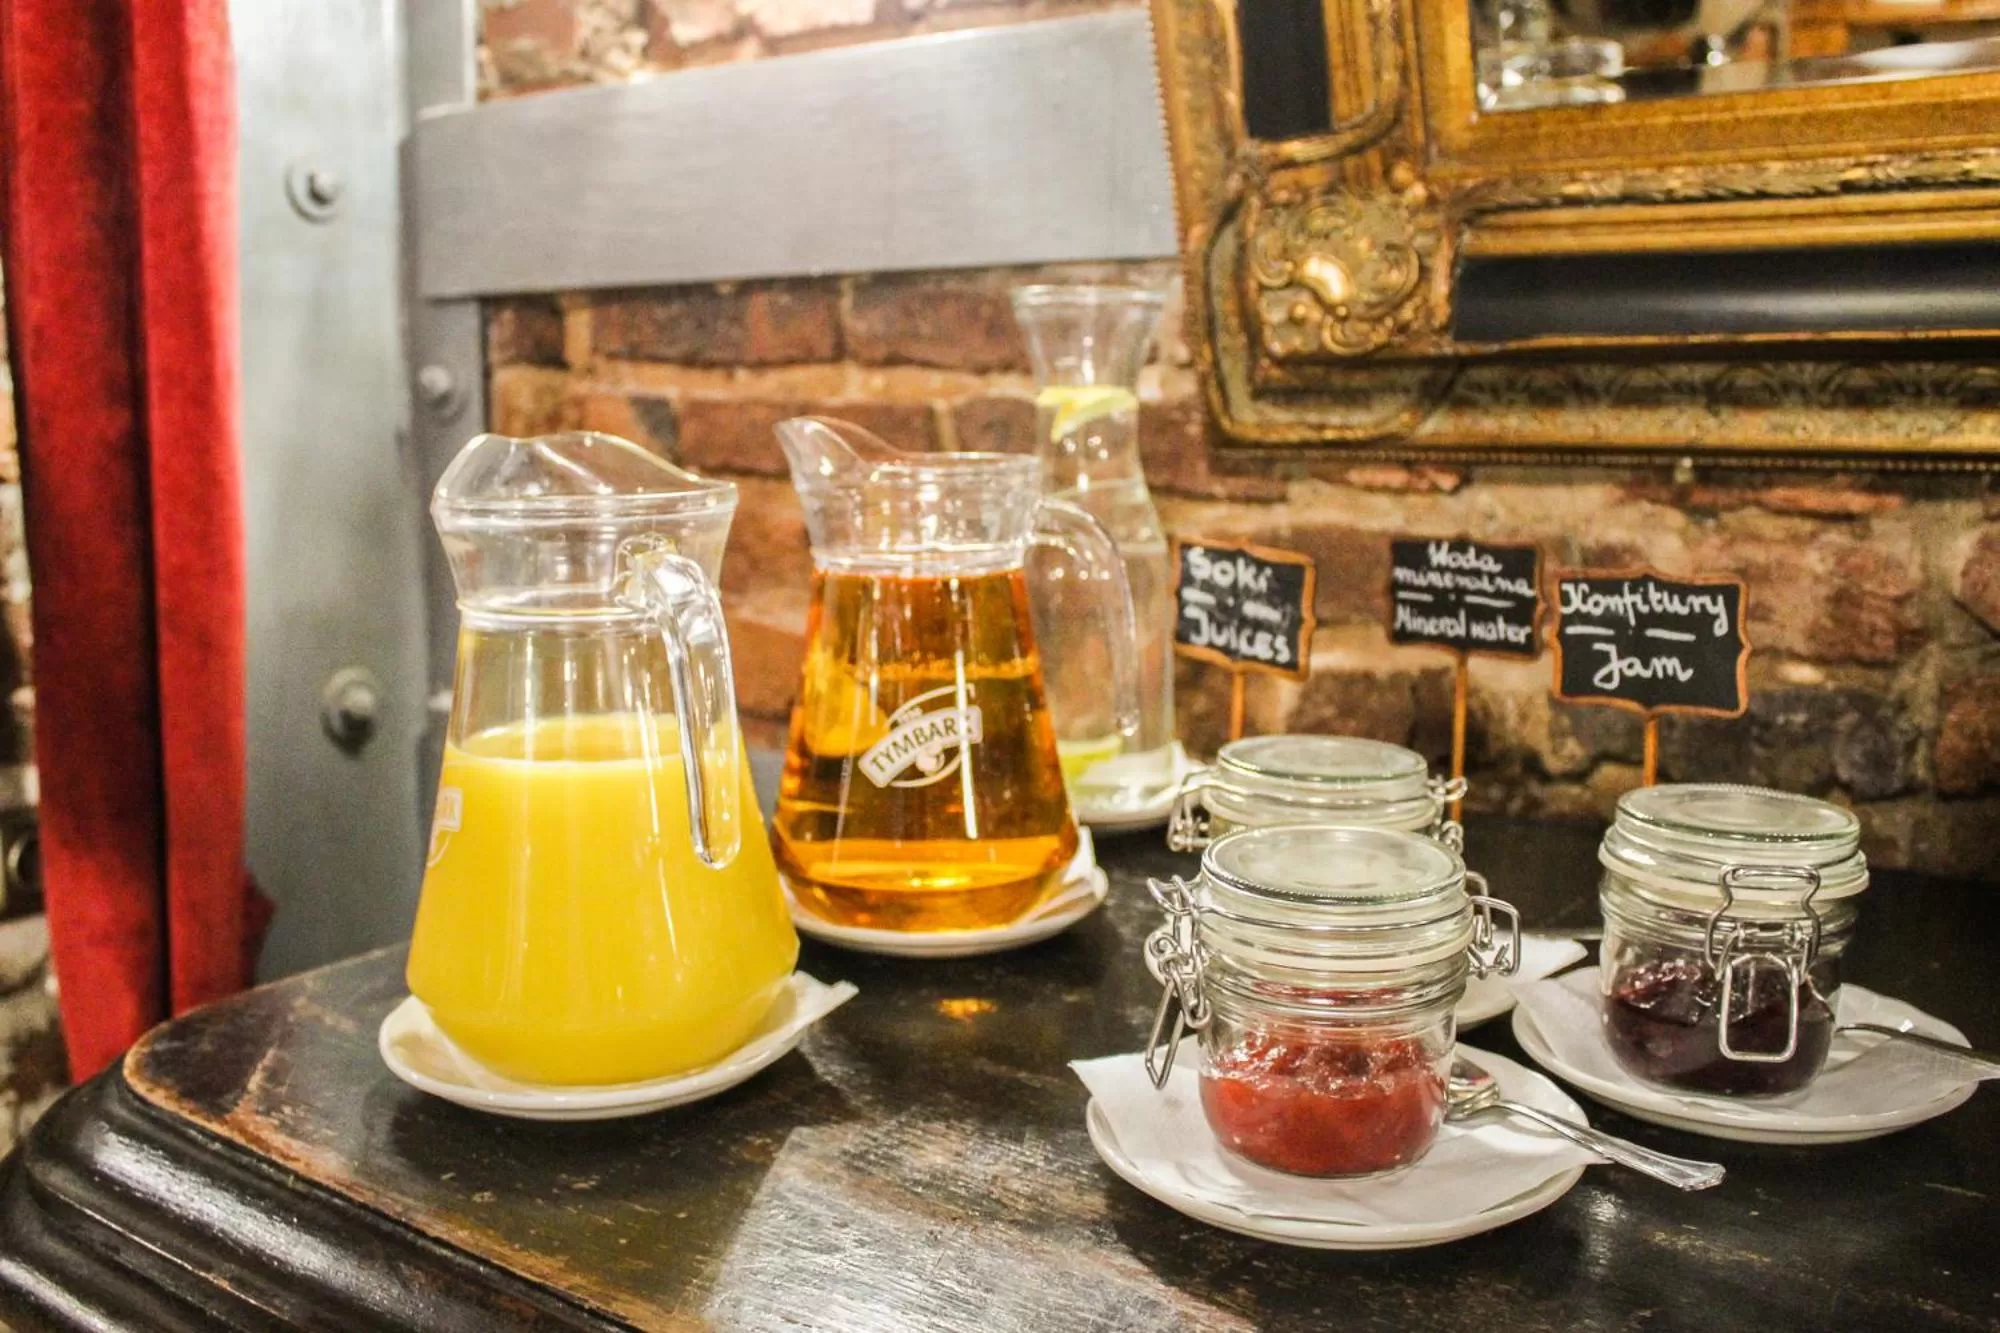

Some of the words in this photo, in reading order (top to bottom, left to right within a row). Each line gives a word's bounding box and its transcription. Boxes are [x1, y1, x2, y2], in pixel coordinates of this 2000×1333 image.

[1187, 546, 1273, 594] Soki
[1428, 541, 1503, 573] Woda
[1394, 603, 1466, 638] Mineral
[1470, 614, 1532, 644] water
[1559, 577, 1729, 637] Konfitury
[1592, 642, 1695, 690] Jam
